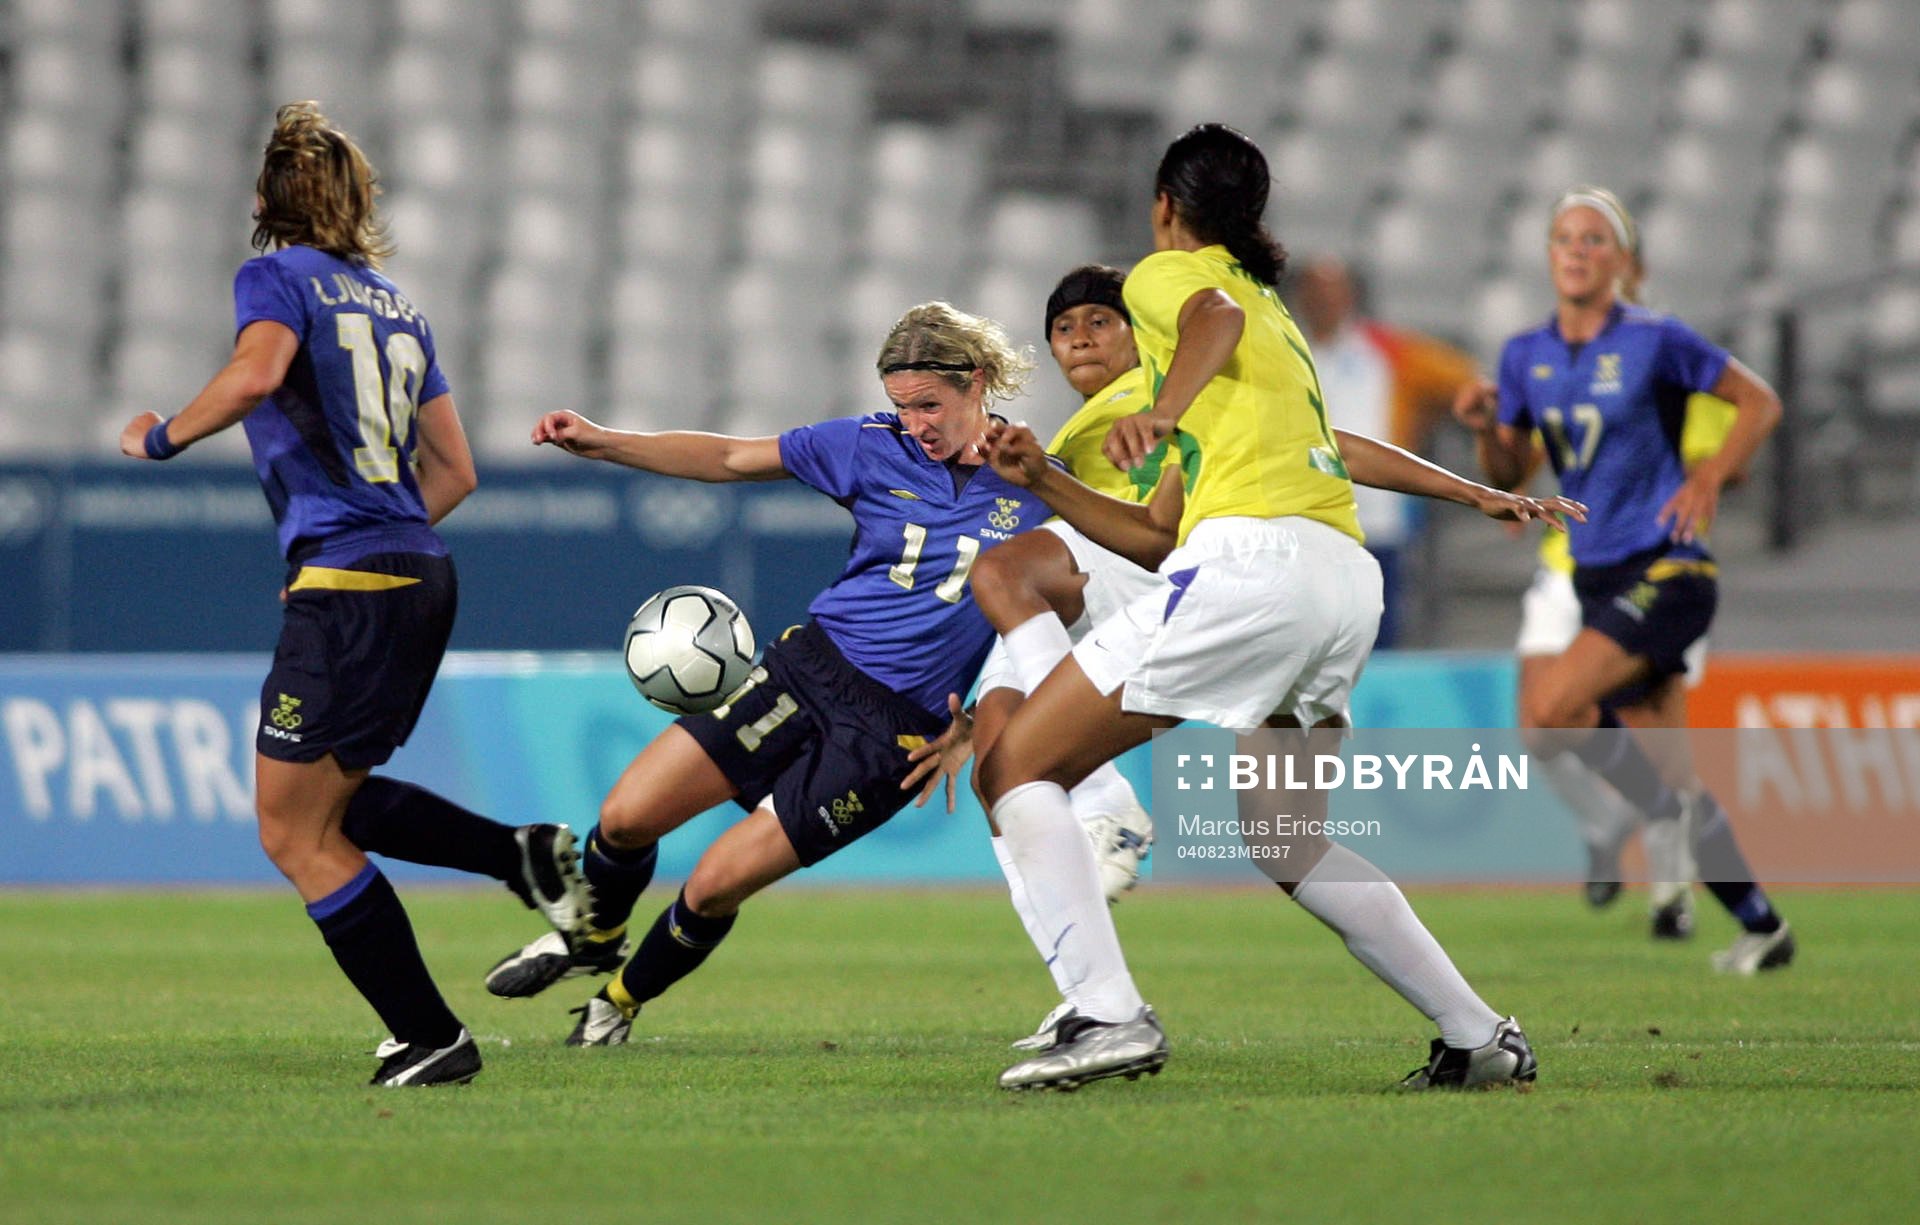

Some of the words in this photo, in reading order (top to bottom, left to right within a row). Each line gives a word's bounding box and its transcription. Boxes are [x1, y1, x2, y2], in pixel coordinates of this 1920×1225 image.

[1542, 403, 1604, 471] 17
[888, 522, 980, 603] 11
[264, 725, 304, 743] SWE
